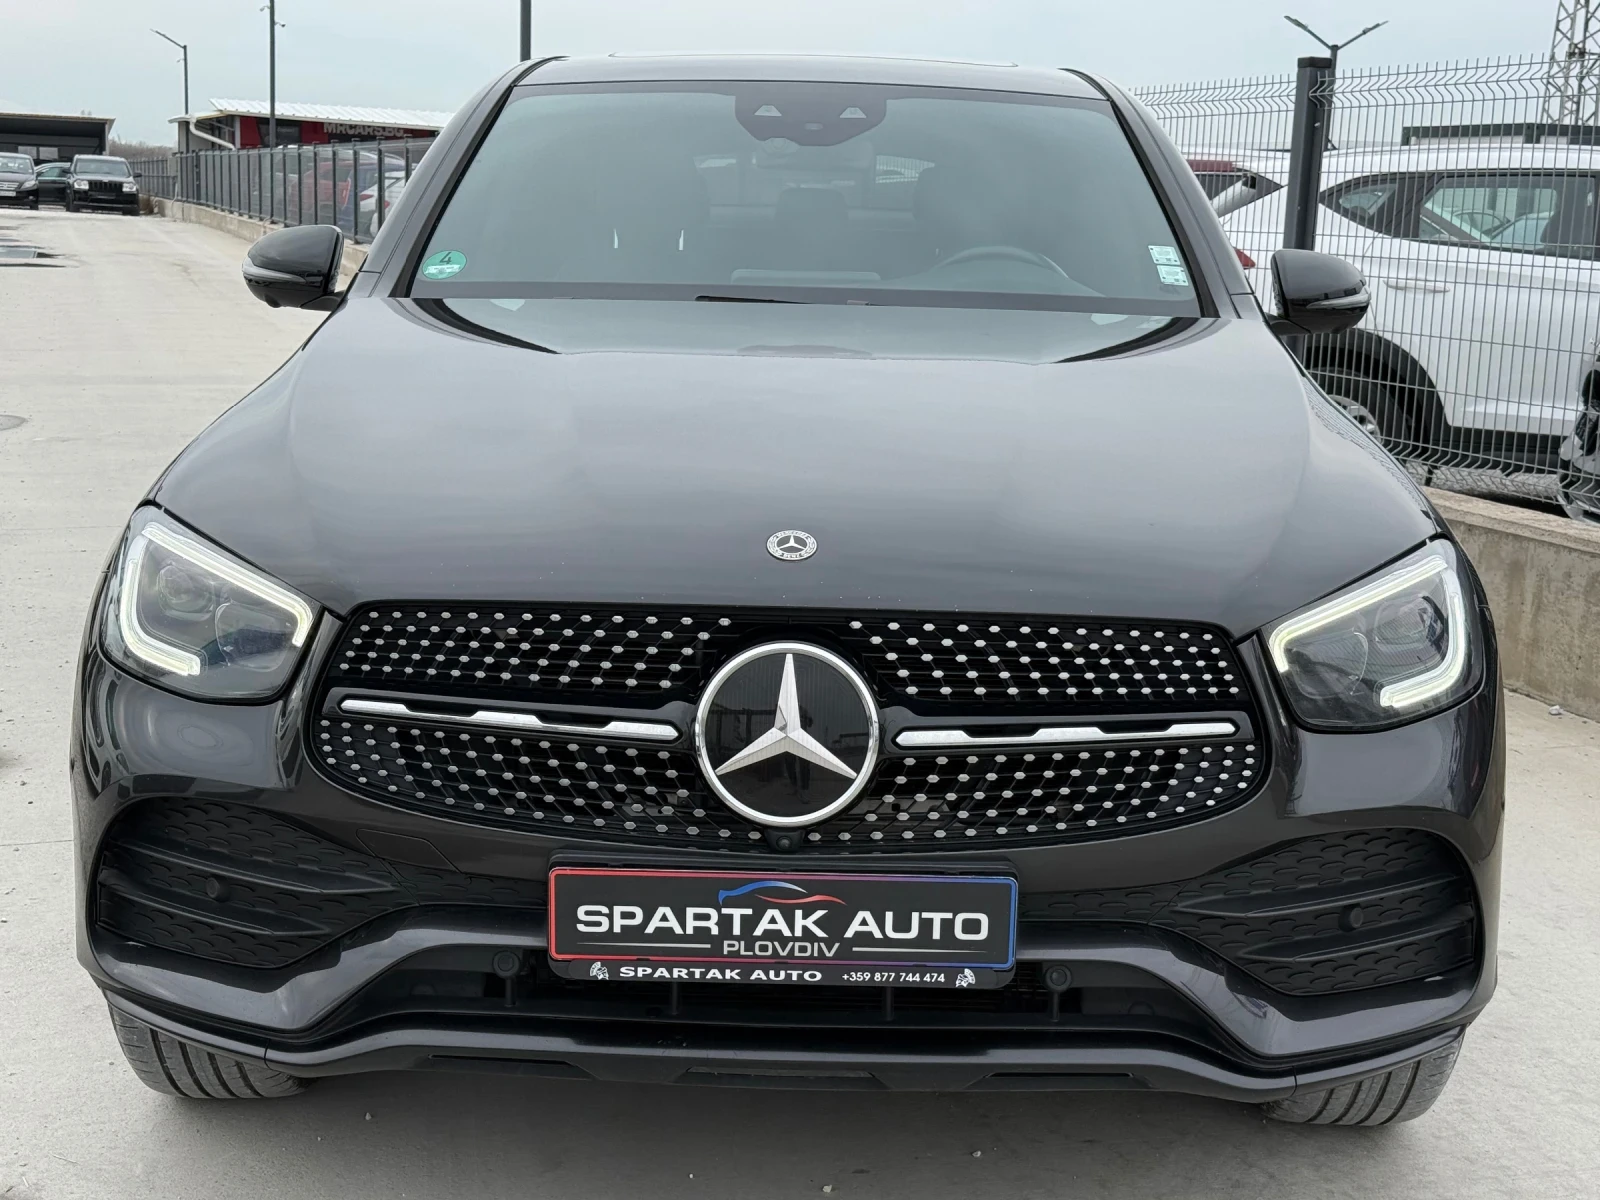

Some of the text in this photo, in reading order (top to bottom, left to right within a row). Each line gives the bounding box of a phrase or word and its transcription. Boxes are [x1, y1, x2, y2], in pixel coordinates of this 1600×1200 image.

[439, 251, 452, 265] 4
[576, 905, 989, 941] SPARTAK AUTO
[723, 940, 840, 957] PLOVDIV
[619, 966, 945, 983] SPARTAK AUTO +359 877 744 474
